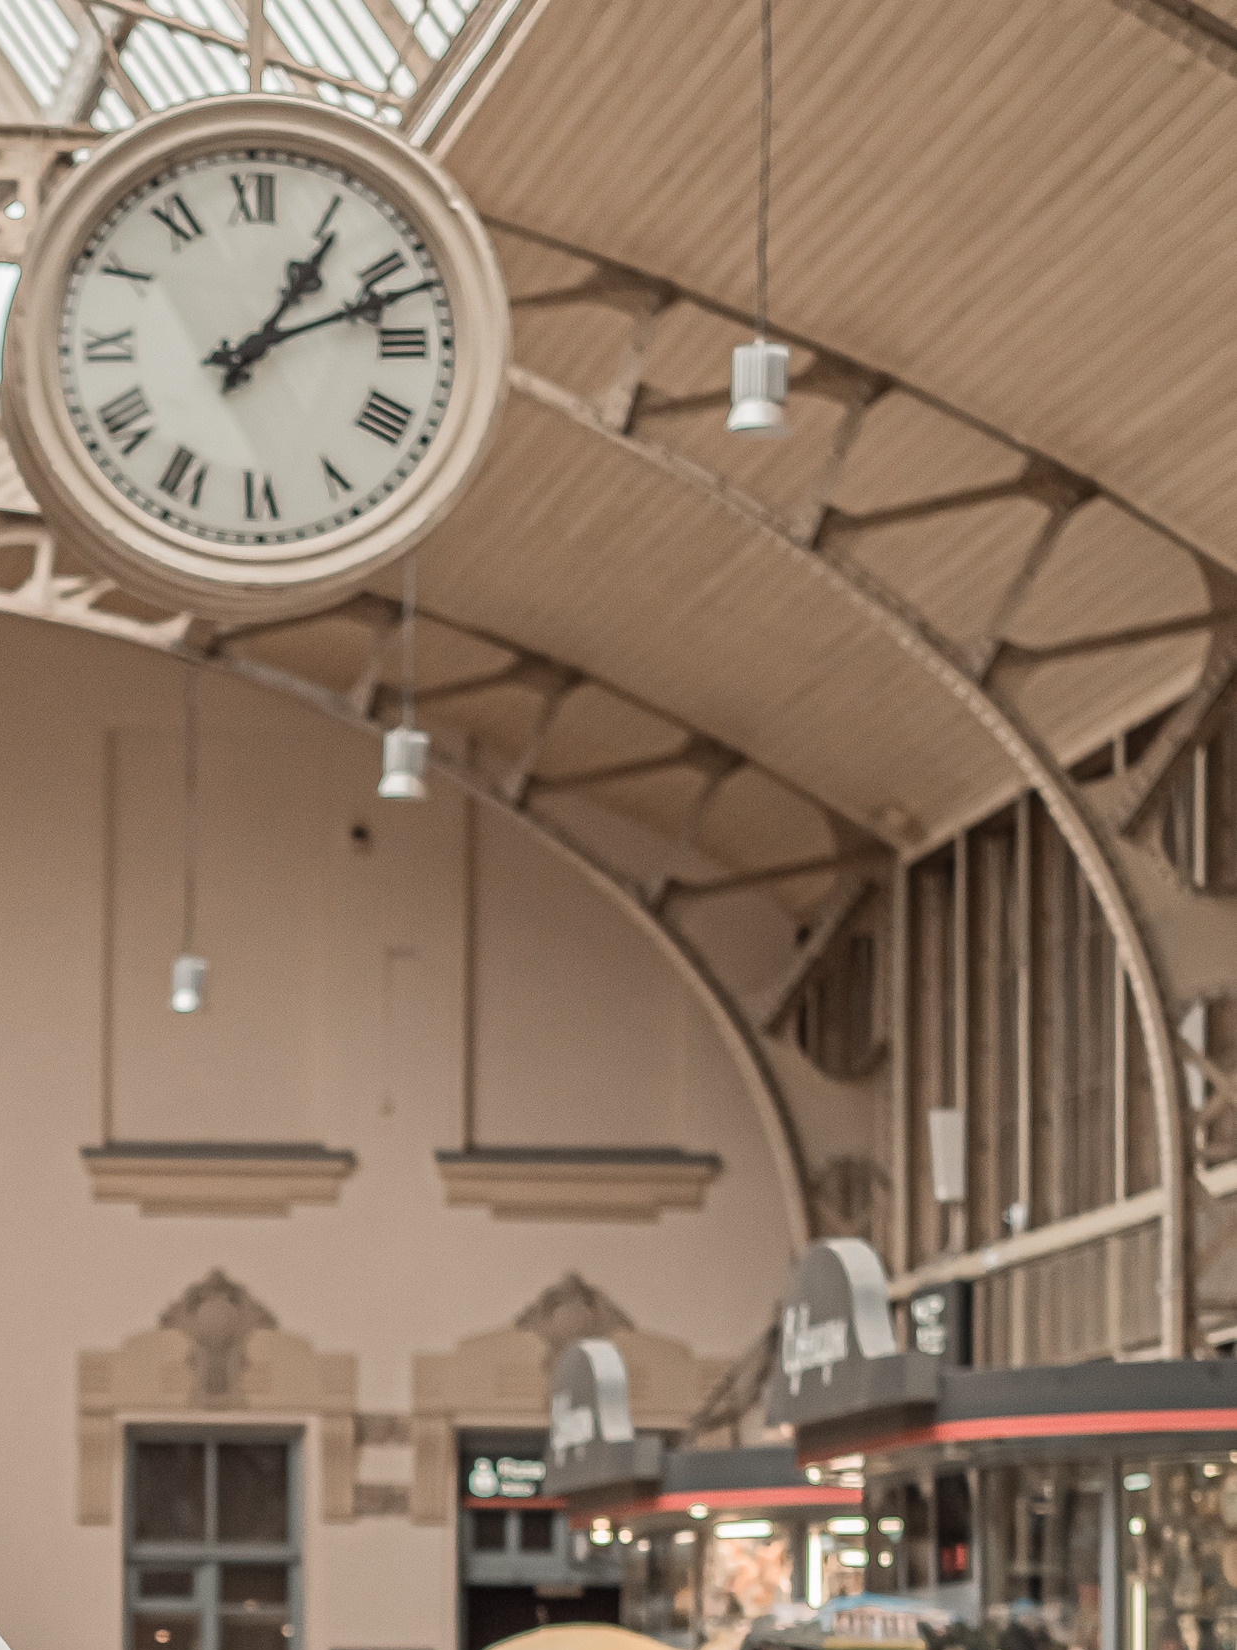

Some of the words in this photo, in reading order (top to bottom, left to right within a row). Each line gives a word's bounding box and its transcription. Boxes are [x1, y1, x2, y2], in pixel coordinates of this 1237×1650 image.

[152, 193, 203, 253] XI
[227, 172, 277, 226] XII
[101, 251, 153, 299] X
[82, 325, 135, 363] IX
[379, 327, 427, 359] III
[98, 387, 156, 456] VIII
[159, 446, 211, 507] VII
[242, 470, 280, 521] VI
